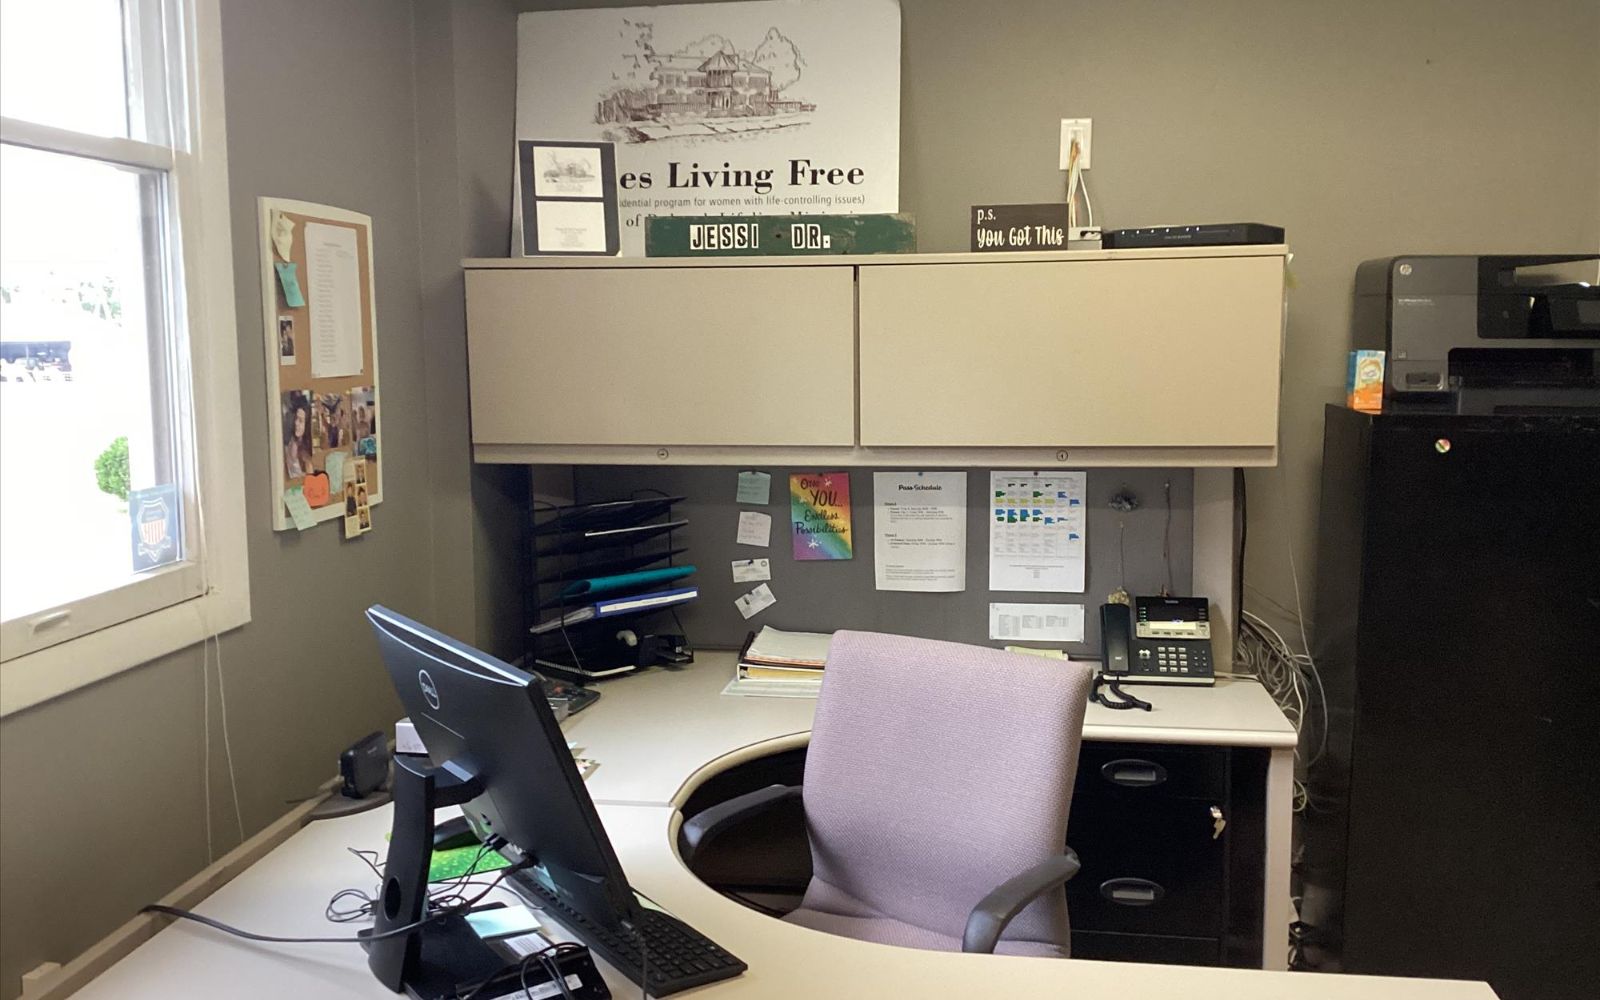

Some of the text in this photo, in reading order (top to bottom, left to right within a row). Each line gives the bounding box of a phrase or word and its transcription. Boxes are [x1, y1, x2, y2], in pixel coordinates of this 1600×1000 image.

[619, 159, 865, 195] es Living Free
[654, 199, 691, 210] program
[694, 197, 706, 206] for
[709, 198, 741, 207] women
[744, 196, 763, 206] with
[834, 194, 865, 205] issues)
[625, 213, 641, 227] of
[977, 208, 997, 225] p.s.
[691, 224, 831, 249] JESSI DR.
[1035, 225, 1065, 246] This
